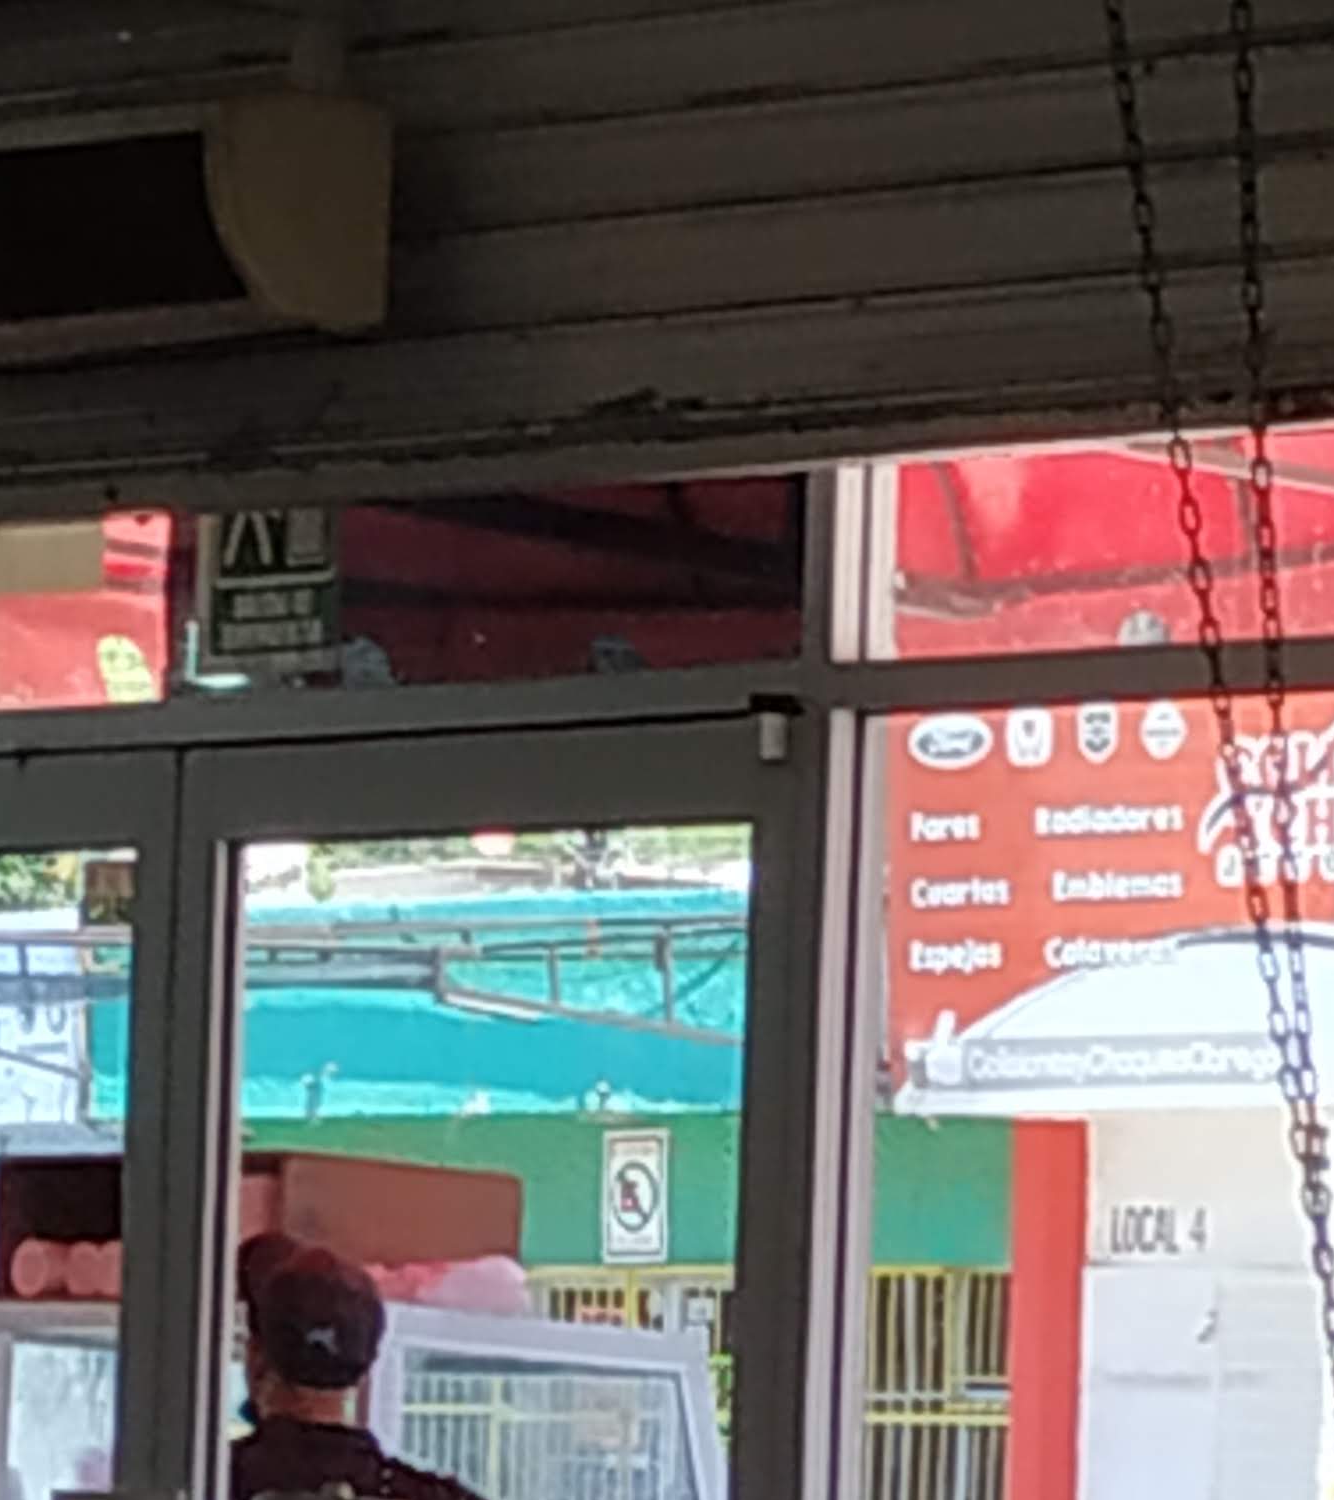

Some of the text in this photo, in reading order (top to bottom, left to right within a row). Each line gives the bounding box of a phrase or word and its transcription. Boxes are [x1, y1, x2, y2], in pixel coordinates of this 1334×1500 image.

[911, 812, 980, 842] Faros
[1035, 806, 1184, 836] Radiadores
[1052, 870, 1183, 902] Emblemas
[909, 938, 1003, 973] Espejos
[1110, 1205, 1207, 1254] LOCAL 4
